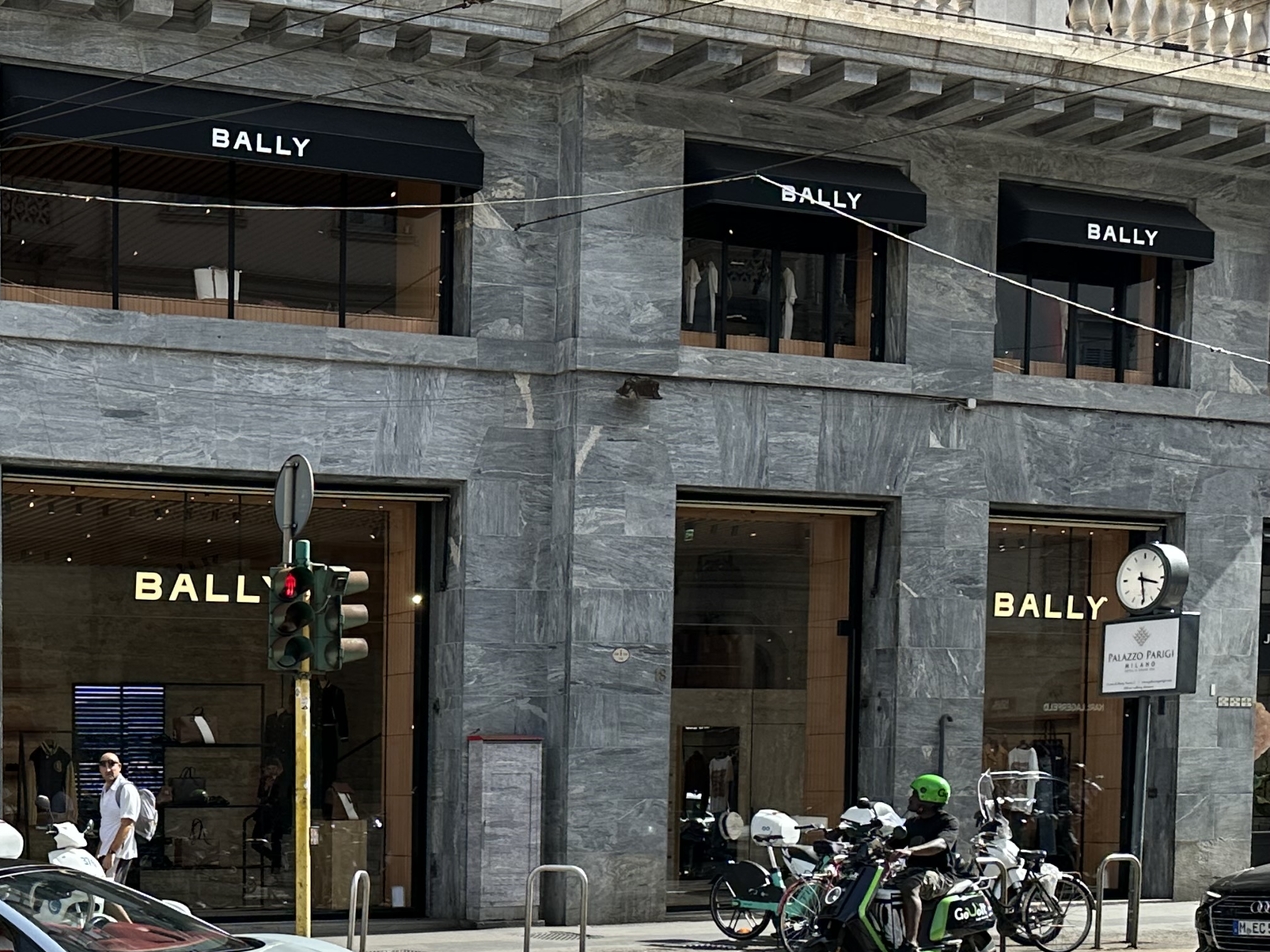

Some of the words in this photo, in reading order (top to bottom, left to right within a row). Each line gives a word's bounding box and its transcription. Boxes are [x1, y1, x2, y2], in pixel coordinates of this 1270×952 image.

[212, 127, 310, 157] BALLY
[782, 184, 862, 210] BALLY
[1088, 223, 1158, 246] BALLY
[135, 571, 271, 603] BALL
[994, 592, 1108, 620] BALLY
[1108, 652, 1143, 662] PALAZZO
[1146, 649, 1174, 660] PARIGI
